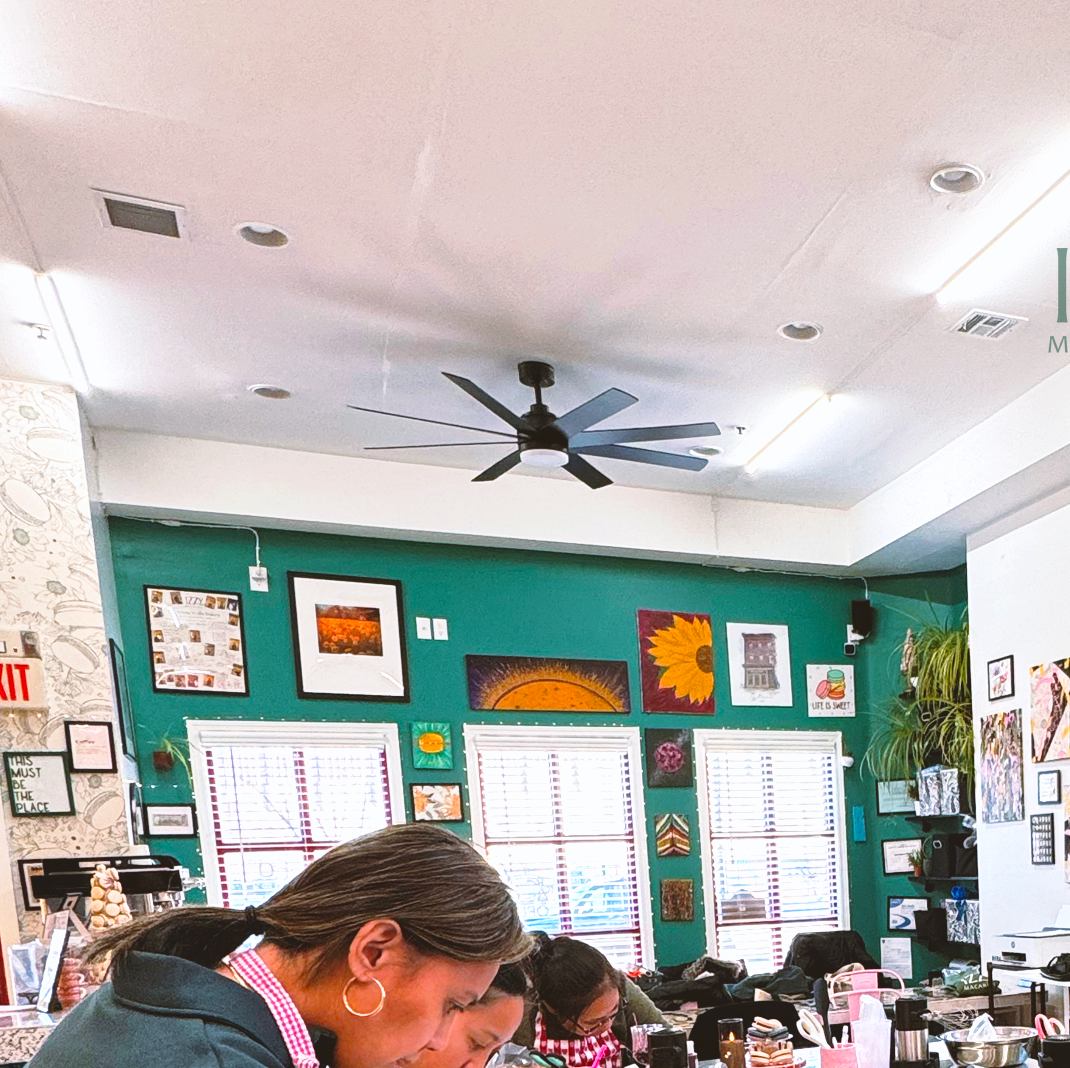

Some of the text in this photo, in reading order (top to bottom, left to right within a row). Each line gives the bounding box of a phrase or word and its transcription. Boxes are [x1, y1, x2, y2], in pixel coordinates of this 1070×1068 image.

[812, 701, 851, 710] LIFE IS SWEET
[9, 755, 33, 766] THIS
[11, 767, 41, 778] MUST
[12, 779, 27, 790] BE
[14, 790, 34, 801] THE
[15, 801, 50, 813] PLACE
